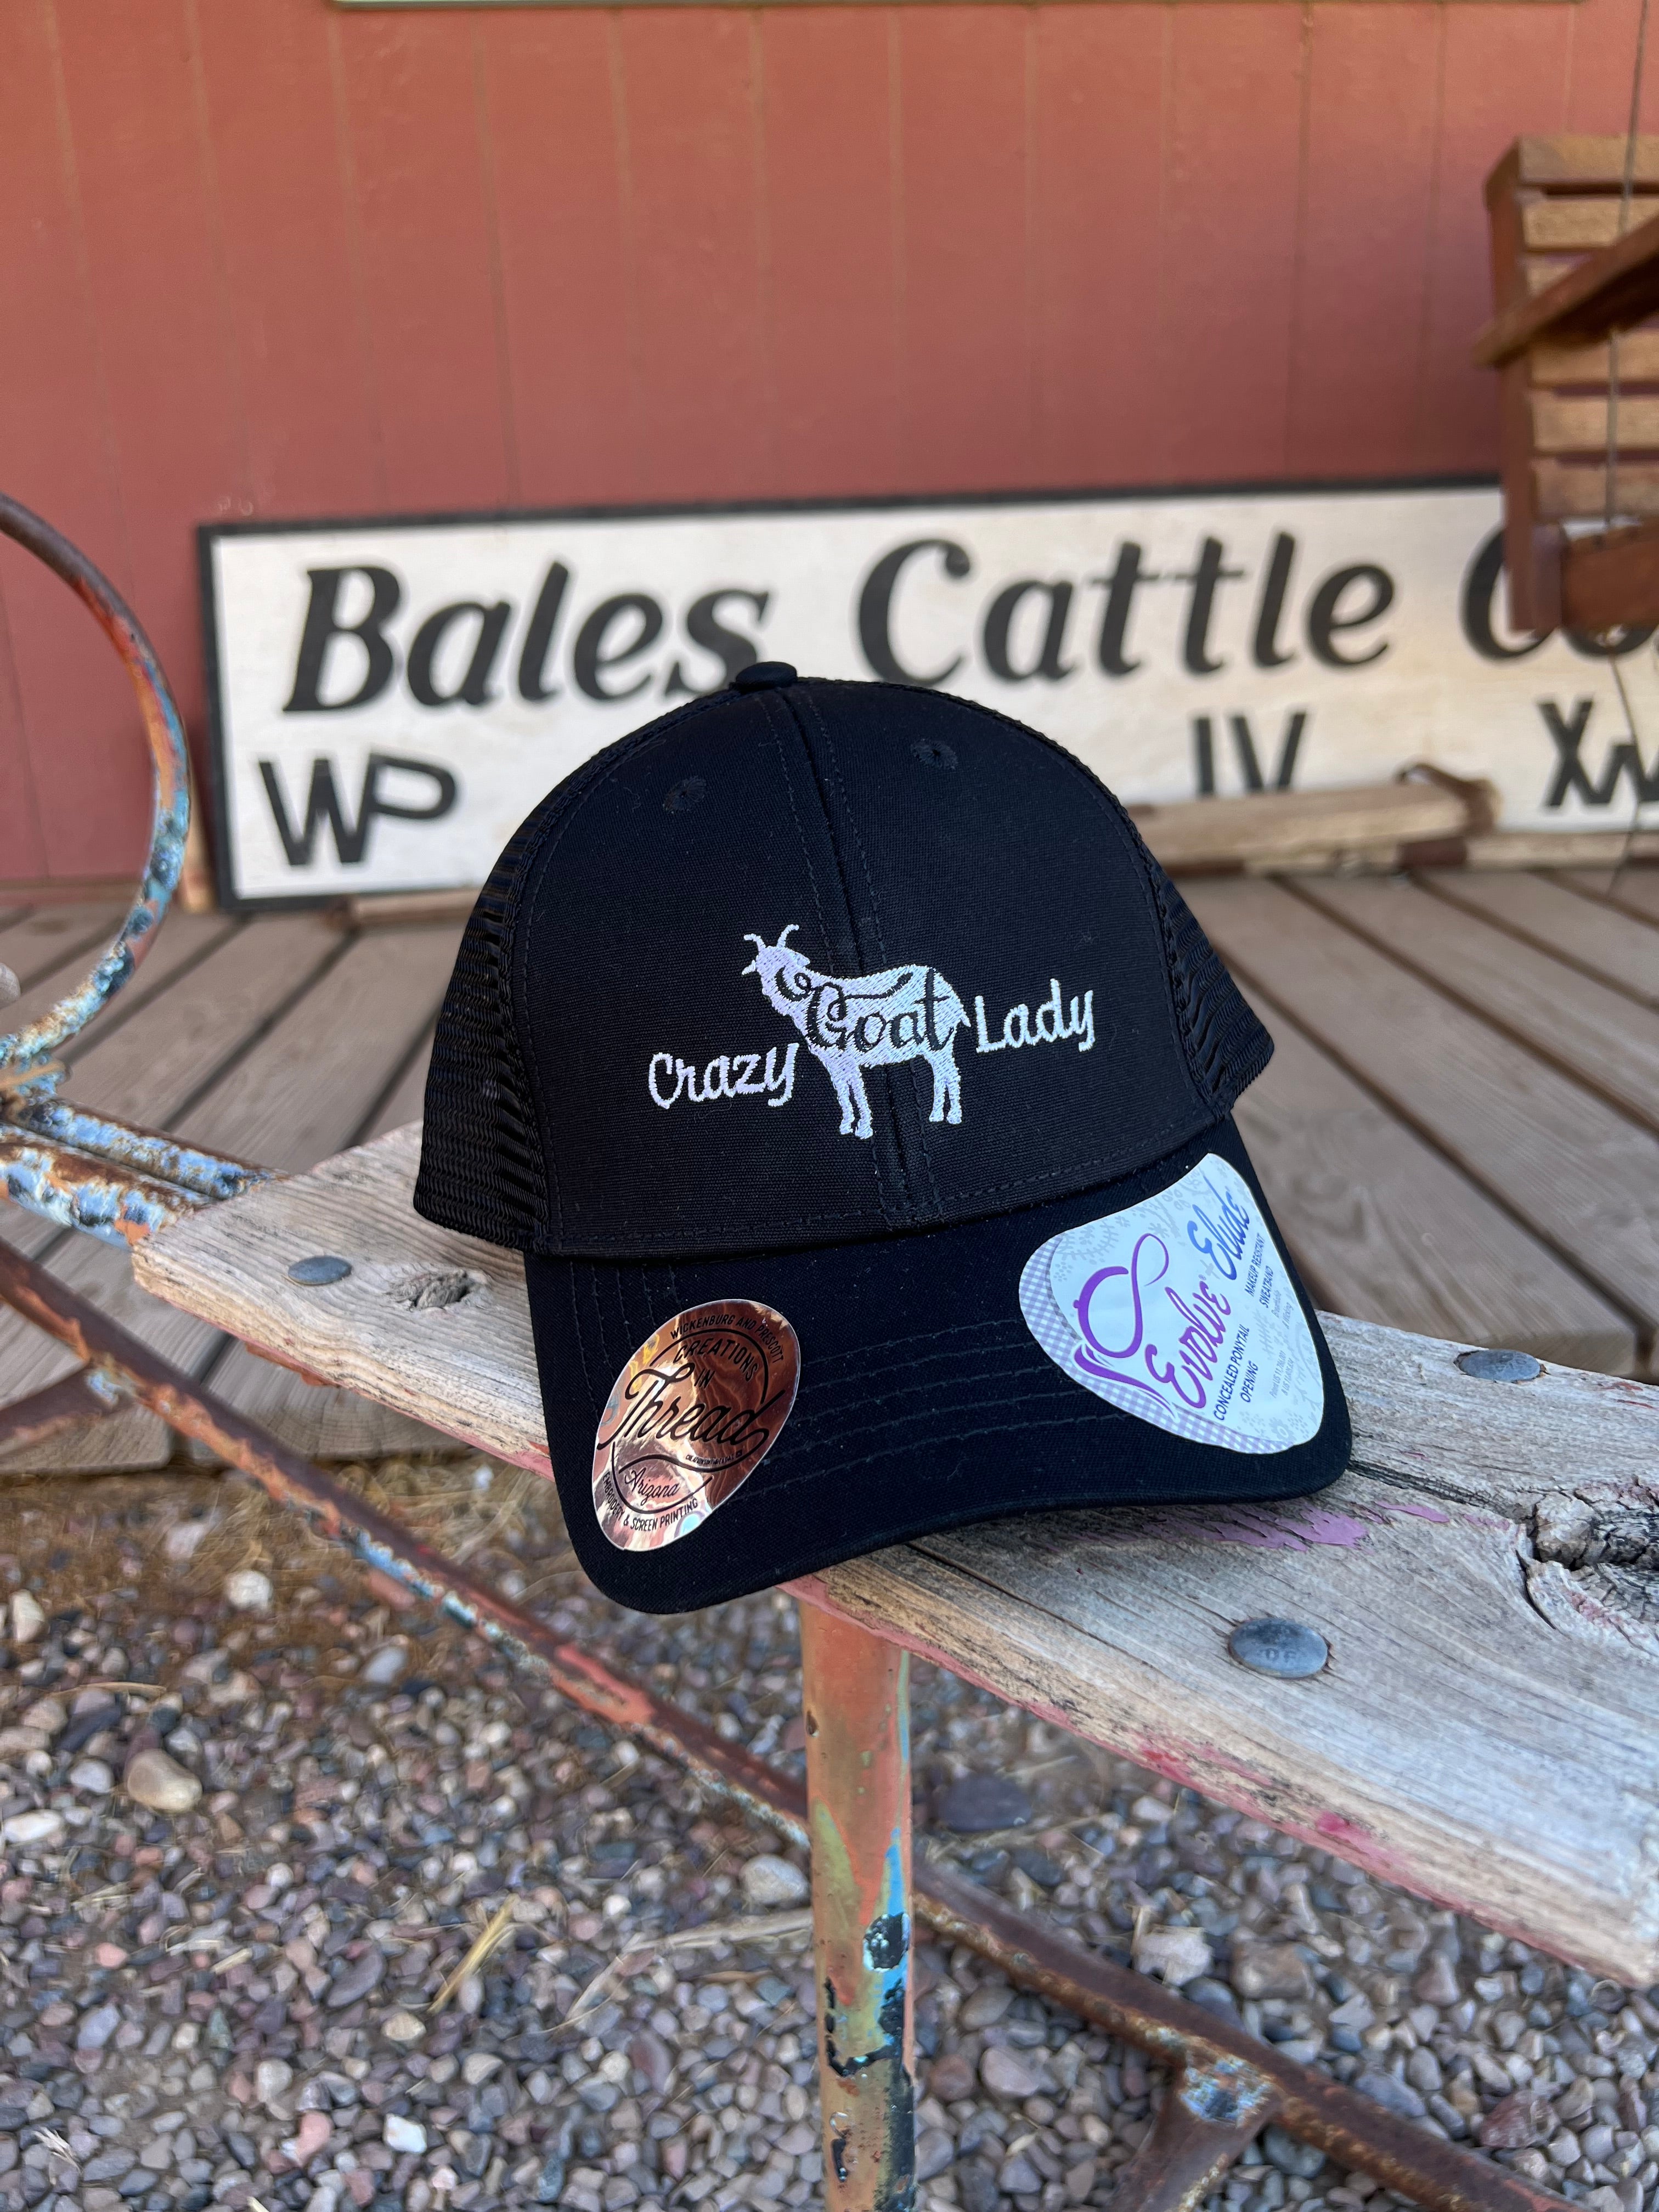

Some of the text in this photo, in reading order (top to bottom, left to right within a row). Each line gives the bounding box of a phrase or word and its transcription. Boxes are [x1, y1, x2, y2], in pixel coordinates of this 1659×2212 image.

[283, 561, 770, 713] Bales
[856, 531, 1398, 686] Cattle
[648, 964, 1094, 1109] Crazy Goat Lady
[1244, 1264, 1259, 1297] MAKEUP
[1259, 1265, 1274, 1309] SWEATBAND
[670, 1314, 784, 1364] WICKENBURG AND PRESCOTT
[673, 1338, 759, 1382] CREATIONS
[694, 1367, 715, 1389] IN
[1213, 1323, 1250, 1421] CONCEALED PONYTAIL
[1240, 1360, 1259, 1403] OPENING
[596, 1363, 786, 1454] Thread
[602, 1471, 625, 1521] EMBROIDERY
[630, 1516, 658, 1532] SCREEN
[659, 1497, 698, 1528] PRINTING
[624, 1467, 681, 1506] Arizona
